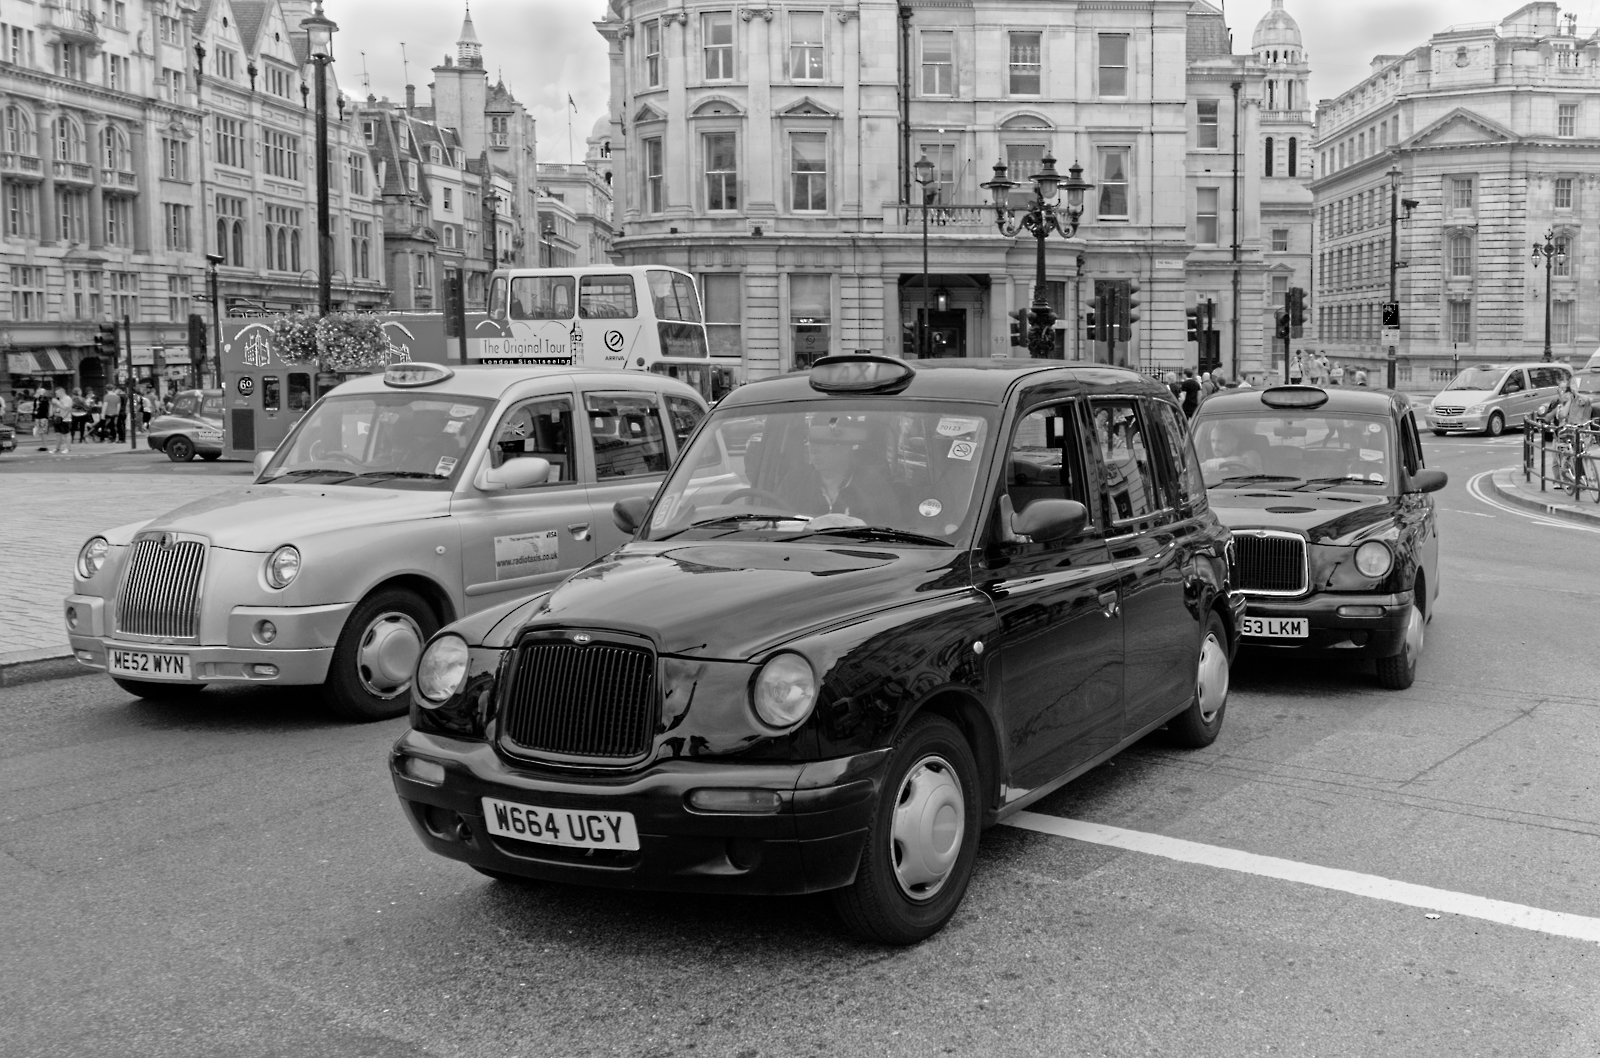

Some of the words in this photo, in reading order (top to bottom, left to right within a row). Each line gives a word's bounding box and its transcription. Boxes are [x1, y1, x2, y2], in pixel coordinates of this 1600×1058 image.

[484, 339, 499, 354] The
[503, 338, 542, 357] Original
[545, 339, 566, 354] Tour
[885, 335, 897, 344] 49
[993, 336, 1005, 344] 49
[823, 364, 881, 381] TAXI
[240, 379, 252, 389] 60
[497, 551, 558, 567] www.radiotaxis.co.uk
[1268, 621, 1301, 635] LKM
[114, 651, 149, 671] ME52
[153, 655, 184, 674] WYN
[494, 803, 560, 839] W664
[566, 814, 622, 843] UGY
